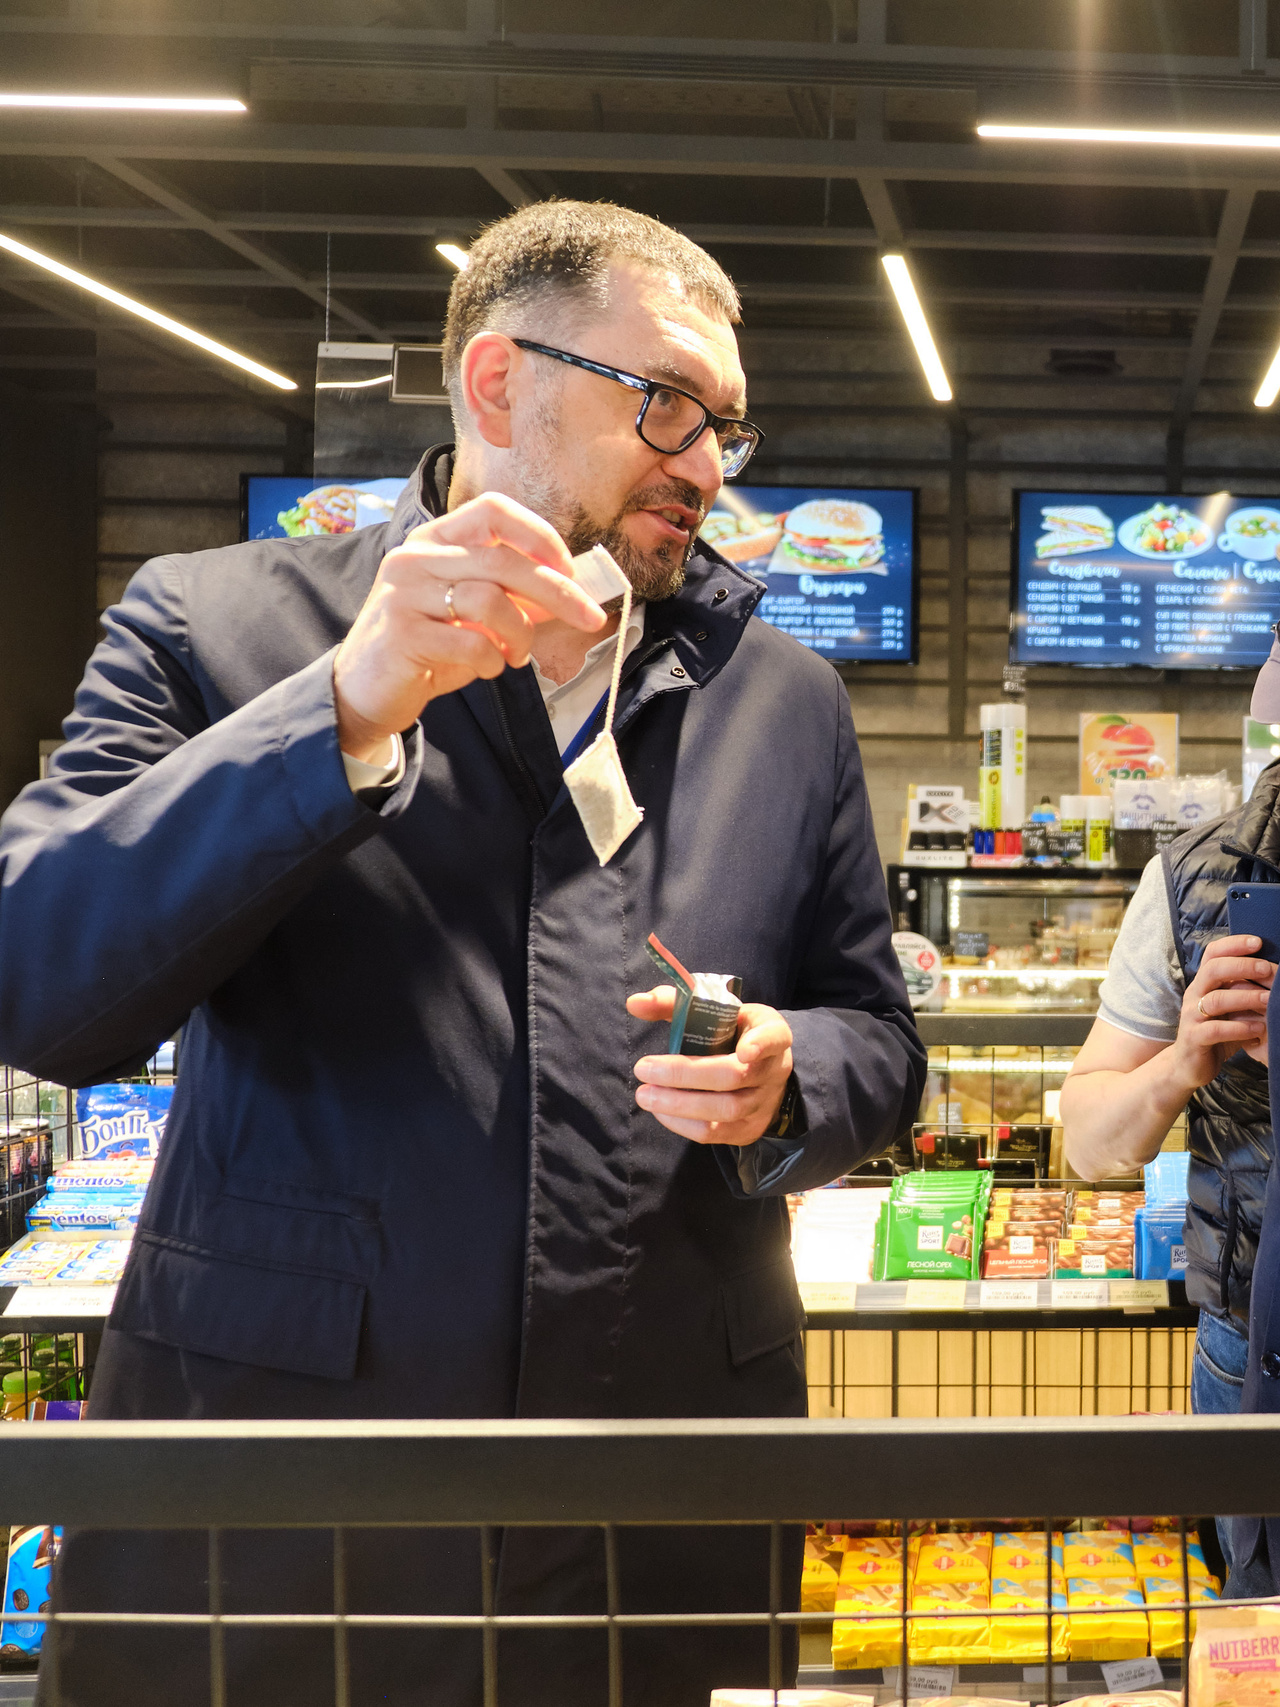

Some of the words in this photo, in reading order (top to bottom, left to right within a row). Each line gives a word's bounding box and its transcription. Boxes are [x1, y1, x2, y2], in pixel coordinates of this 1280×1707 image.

[1027, 582, 1059, 590] СЕНДВИЧ
[1068, 582, 1100, 591] КУРИЦЕЙ
[1156, 584, 1194, 593] ГРЕЧЕСКИЙ
[1027, 593, 1059, 602] СЕНДВИЧ
[1067, 593, 1103, 603] ВЕТЧИНОЙ
[1156, 596, 1183, 604] ЦЕЗАРЬ
[768, 604, 811, 613] МРАМОРНОЙ
[813, 605, 854, 614] ГОВЯДИНОЙ
[882, 607, 894, 615] 299
[1027, 603, 1059, 612] ГОРЯЧИЙ
[1061, 604, 1079, 612] ТОСТ
[1067, 615, 1103, 624] ВЕТЧИНОЙ
[1156, 612, 1169, 620] СУП
[814, 616, 854, 625] ЛОСЯТИНОЙ
[882, 618, 894, 626] 369
[1027, 626, 1060, 634] КРУАСАН
[1156, 622, 1169, 630] СУП
[822, 627, 859, 637] ИНДЕЙКОЙ
[882, 629, 894, 637] 279
[1034, 637, 1057, 645] СЫРОМ
[1067, 637, 1103, 646] ВЕТЧИНОЙ
[1156, 633, 1169, 641] СУП
[815, 639, 835, 648] ФРЕШ
[882, 640, 894, 648] 259
[1119, 811, 1168, 821] ЗАЩИТНЫЕ
[55, 1176, 125, 1187] mentos
[907, 1260, 935, 1269] ЛЕСНОЙ
[936, 1261, 952, 1269] ОРЕХ
